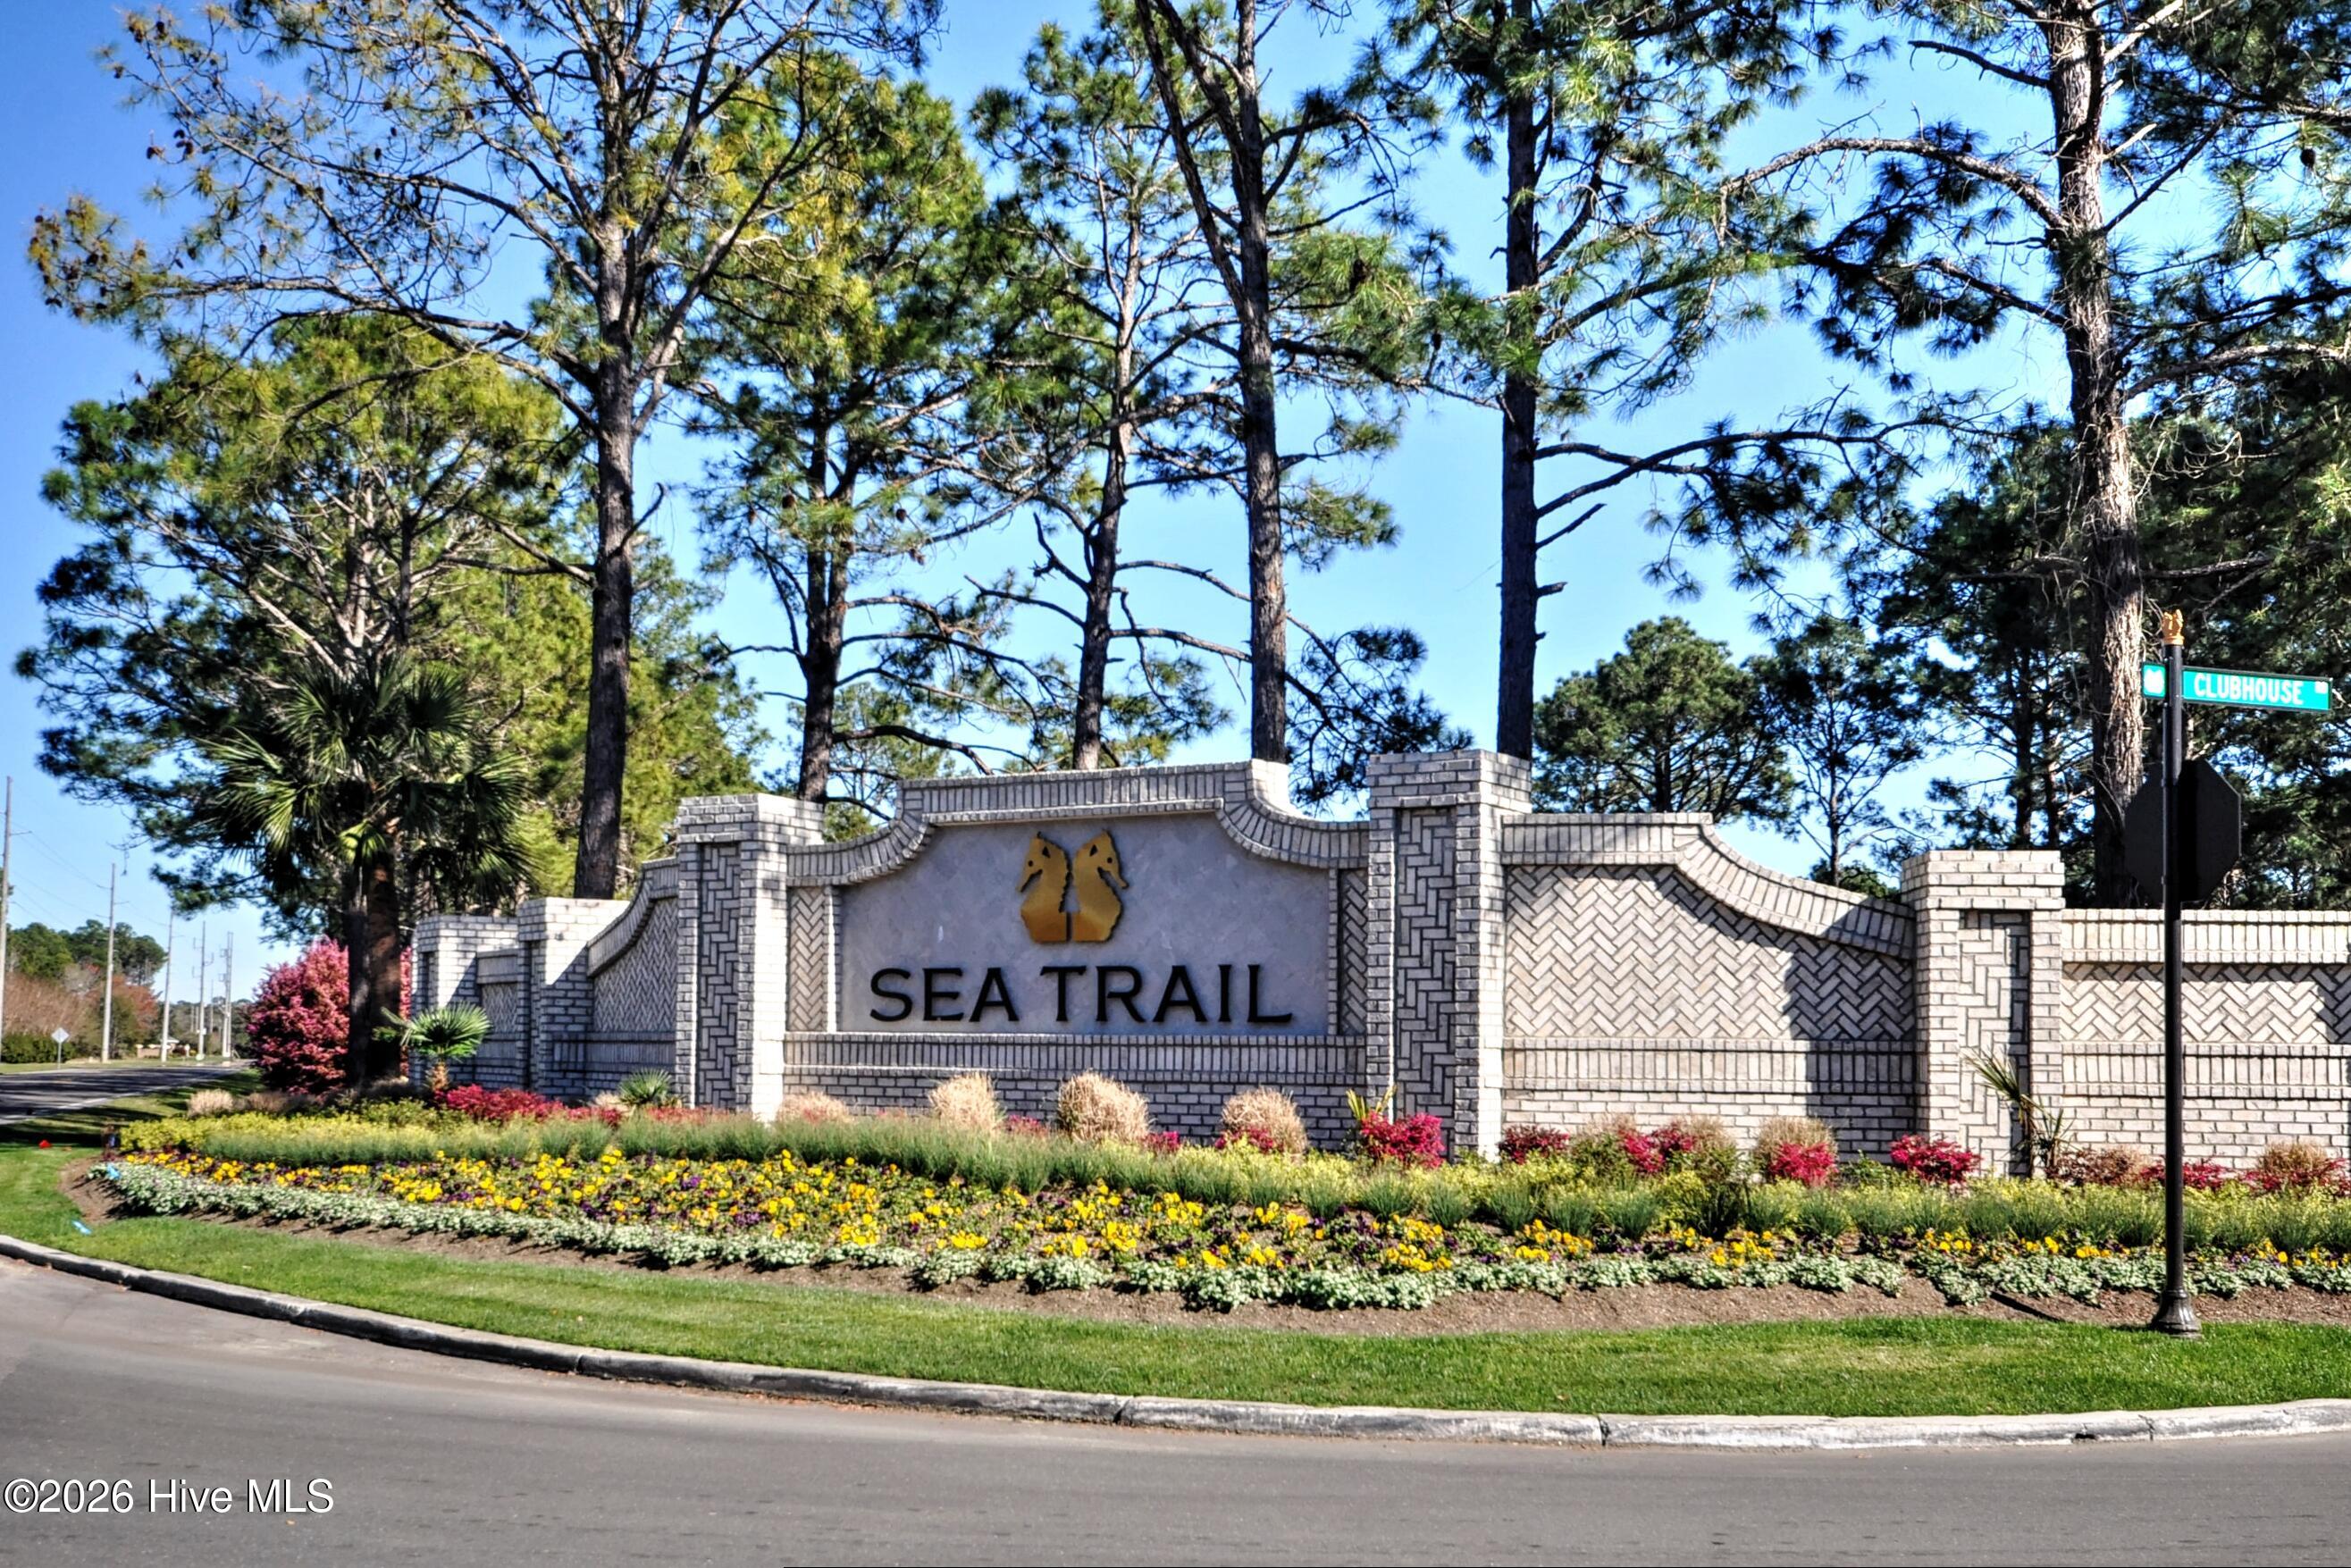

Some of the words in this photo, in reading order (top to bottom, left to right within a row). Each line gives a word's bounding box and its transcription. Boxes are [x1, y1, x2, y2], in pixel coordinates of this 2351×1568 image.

[2194, 673, 2304, 705] CLUBHOUSE
[869, 966, 1019, 1022] SEA
[1039, 963, 1293, 1023] TRAIL
